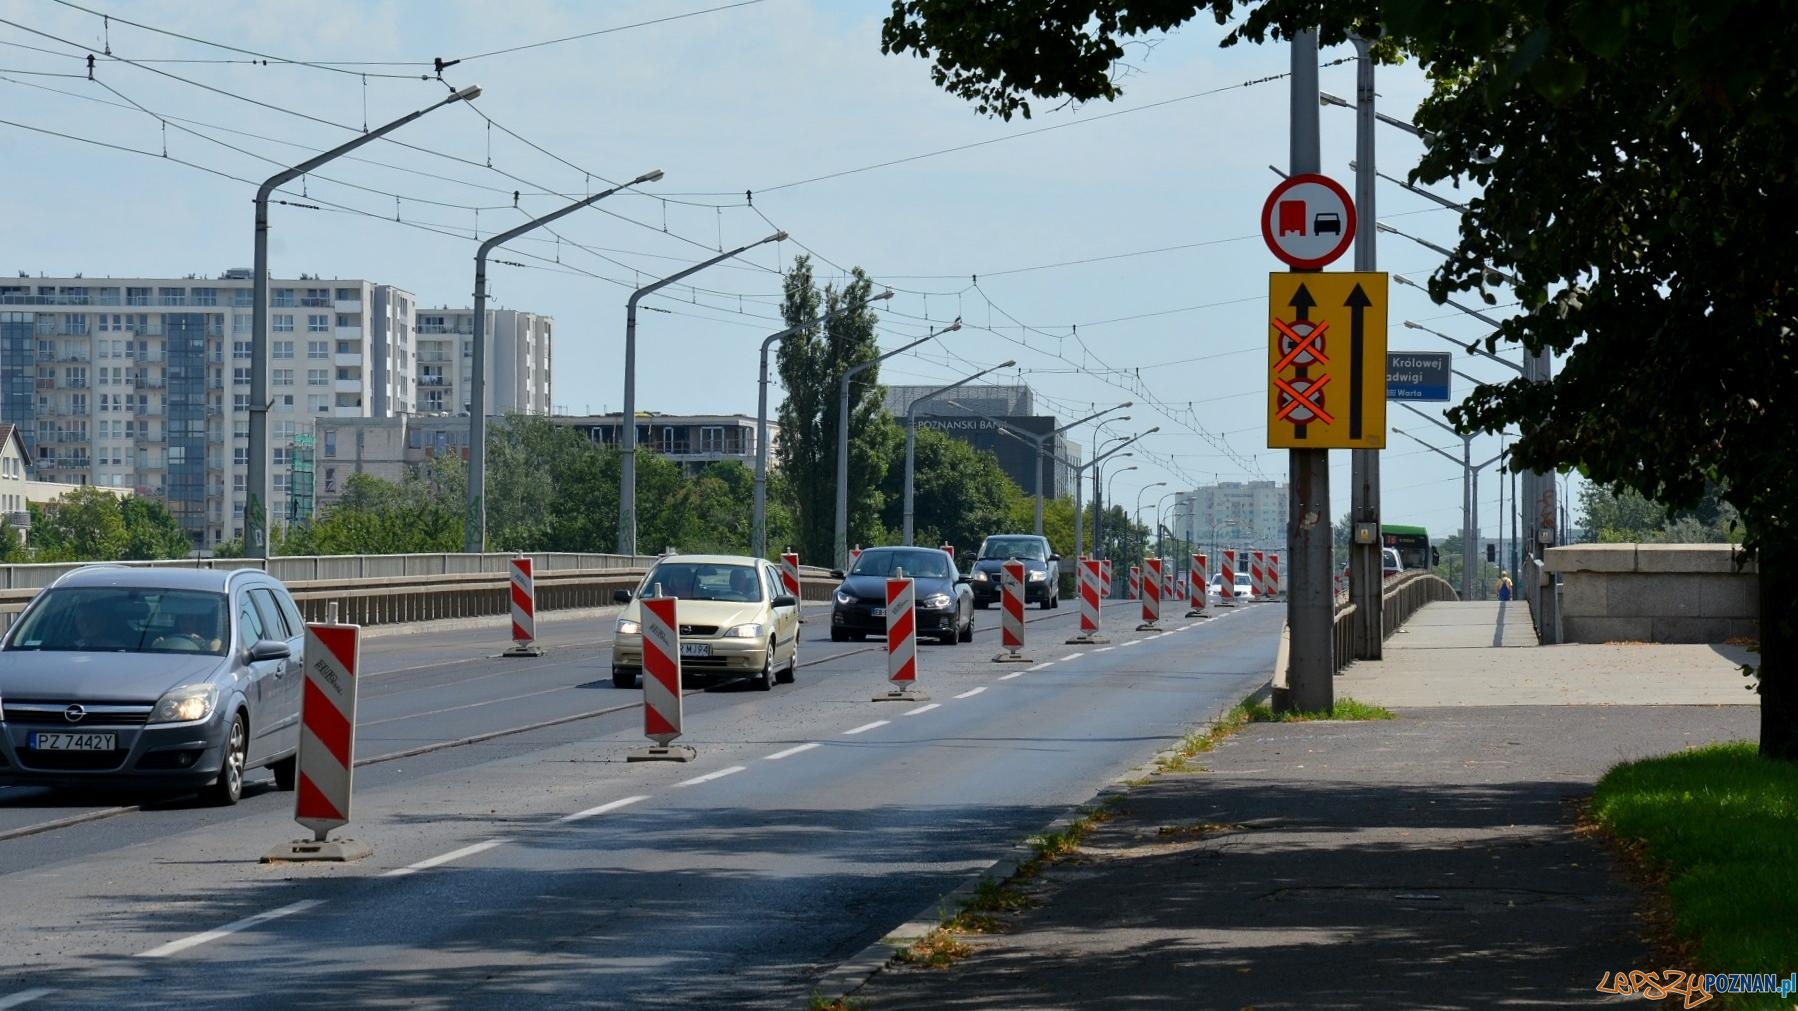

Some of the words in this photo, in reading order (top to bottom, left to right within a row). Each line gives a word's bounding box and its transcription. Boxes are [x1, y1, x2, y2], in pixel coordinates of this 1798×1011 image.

[1392, 357, 1442, 370] Królowej
[1386, 371, 1423, 384] adwigi
[1397, 389, 1422, 397] Warta
[918, 418, 977, 430] POZNAŃSKI
[38, 734, 60, 749] PZ
[66, 734, 113, 750] 7442Y
